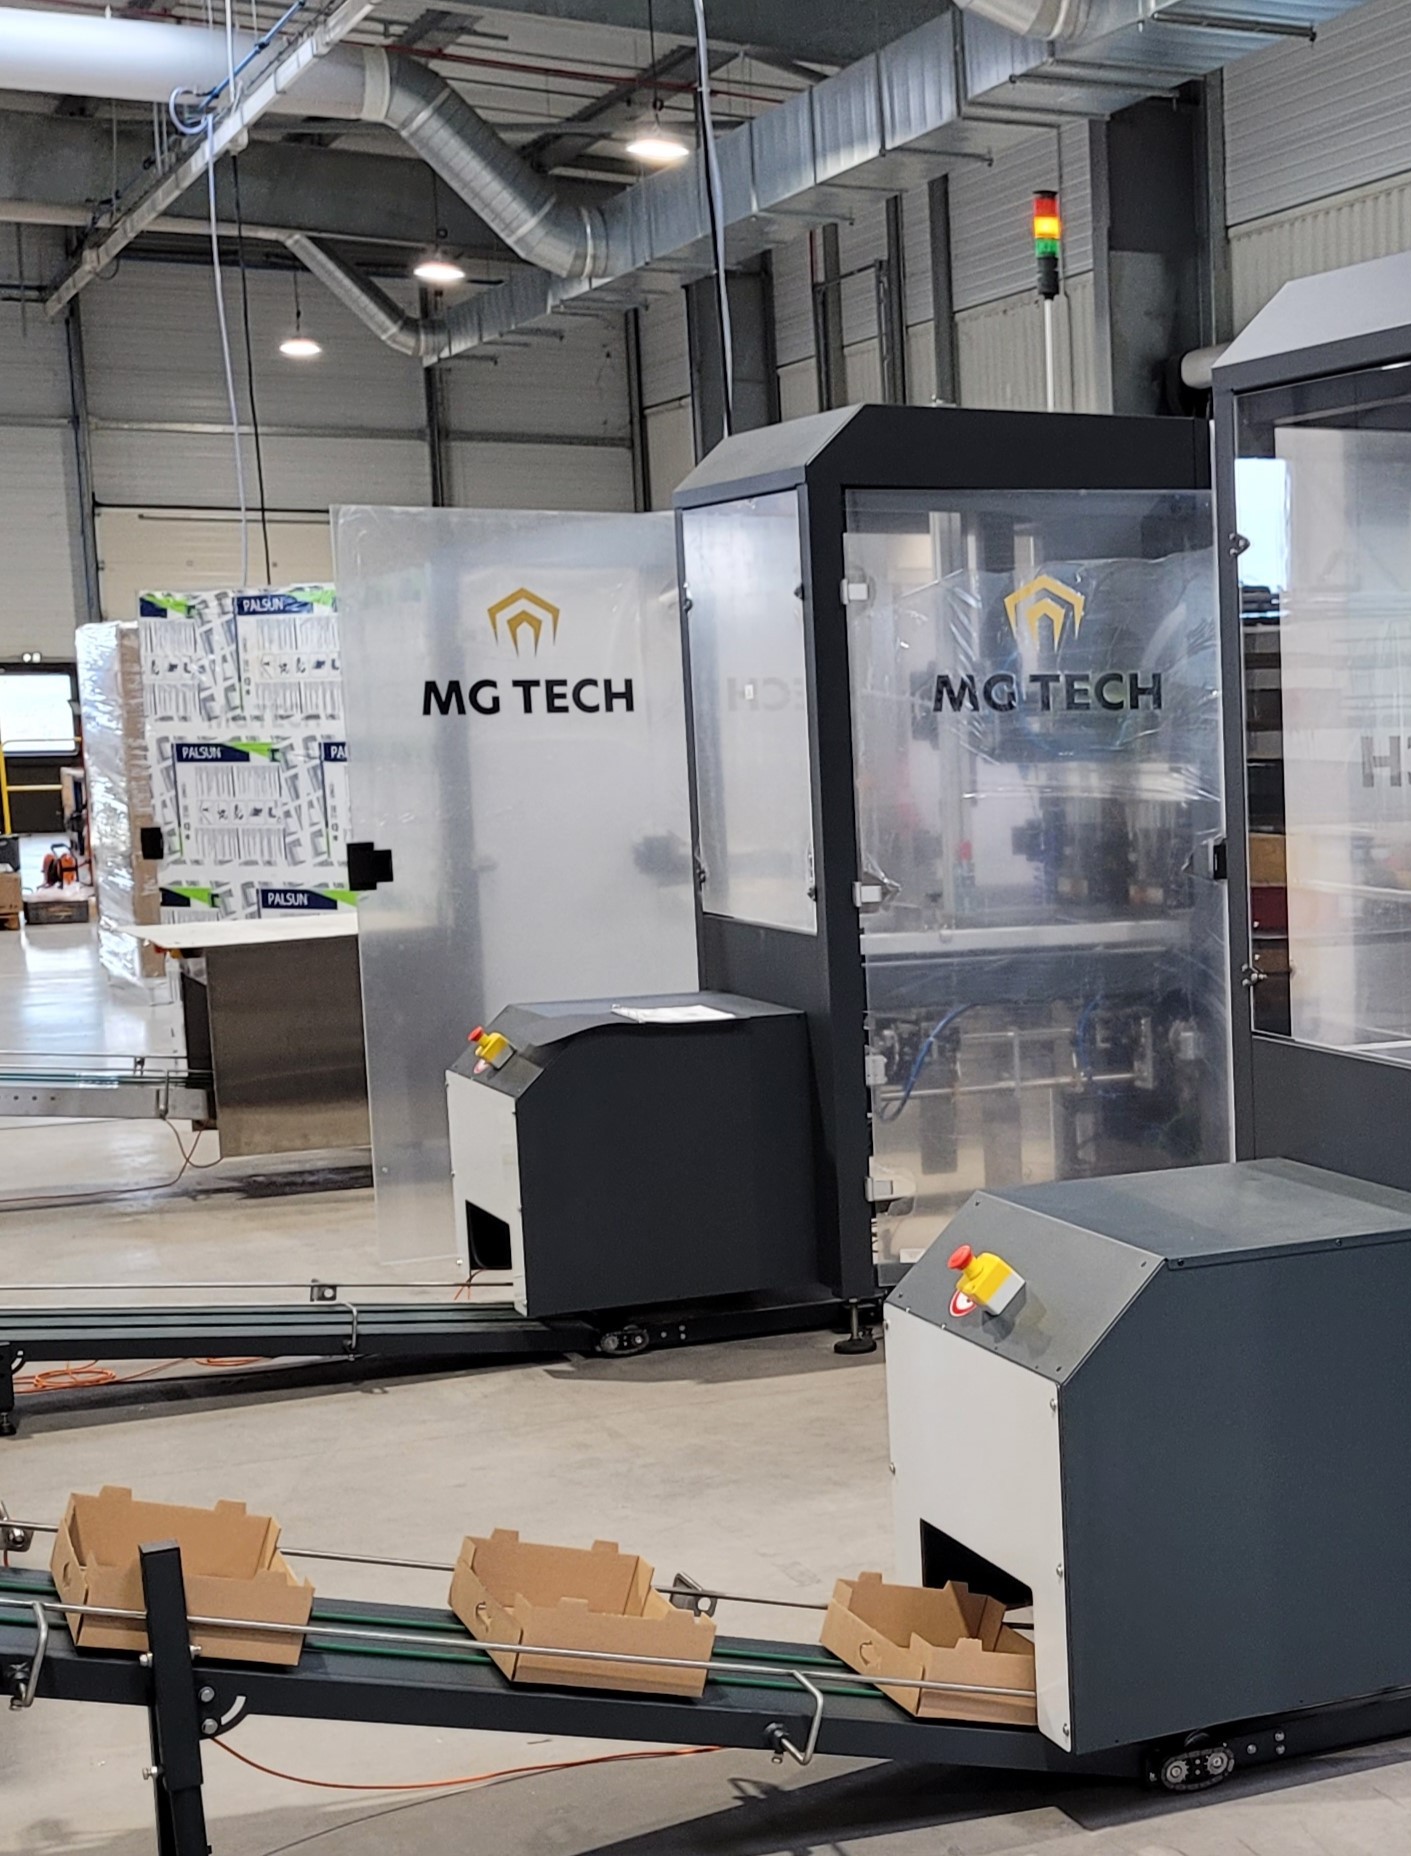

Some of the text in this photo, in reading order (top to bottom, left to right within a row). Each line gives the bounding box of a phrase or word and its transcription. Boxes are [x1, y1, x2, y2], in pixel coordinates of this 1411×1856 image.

[243, 599, 285, 613] PALSUN
[422, 678, 635, 716] MG TECH
[932, 671, 1163, 713] MG TECH
[182, 746, 222, 760] PALSUN
[268, 892, 309, 907] PALSUN
